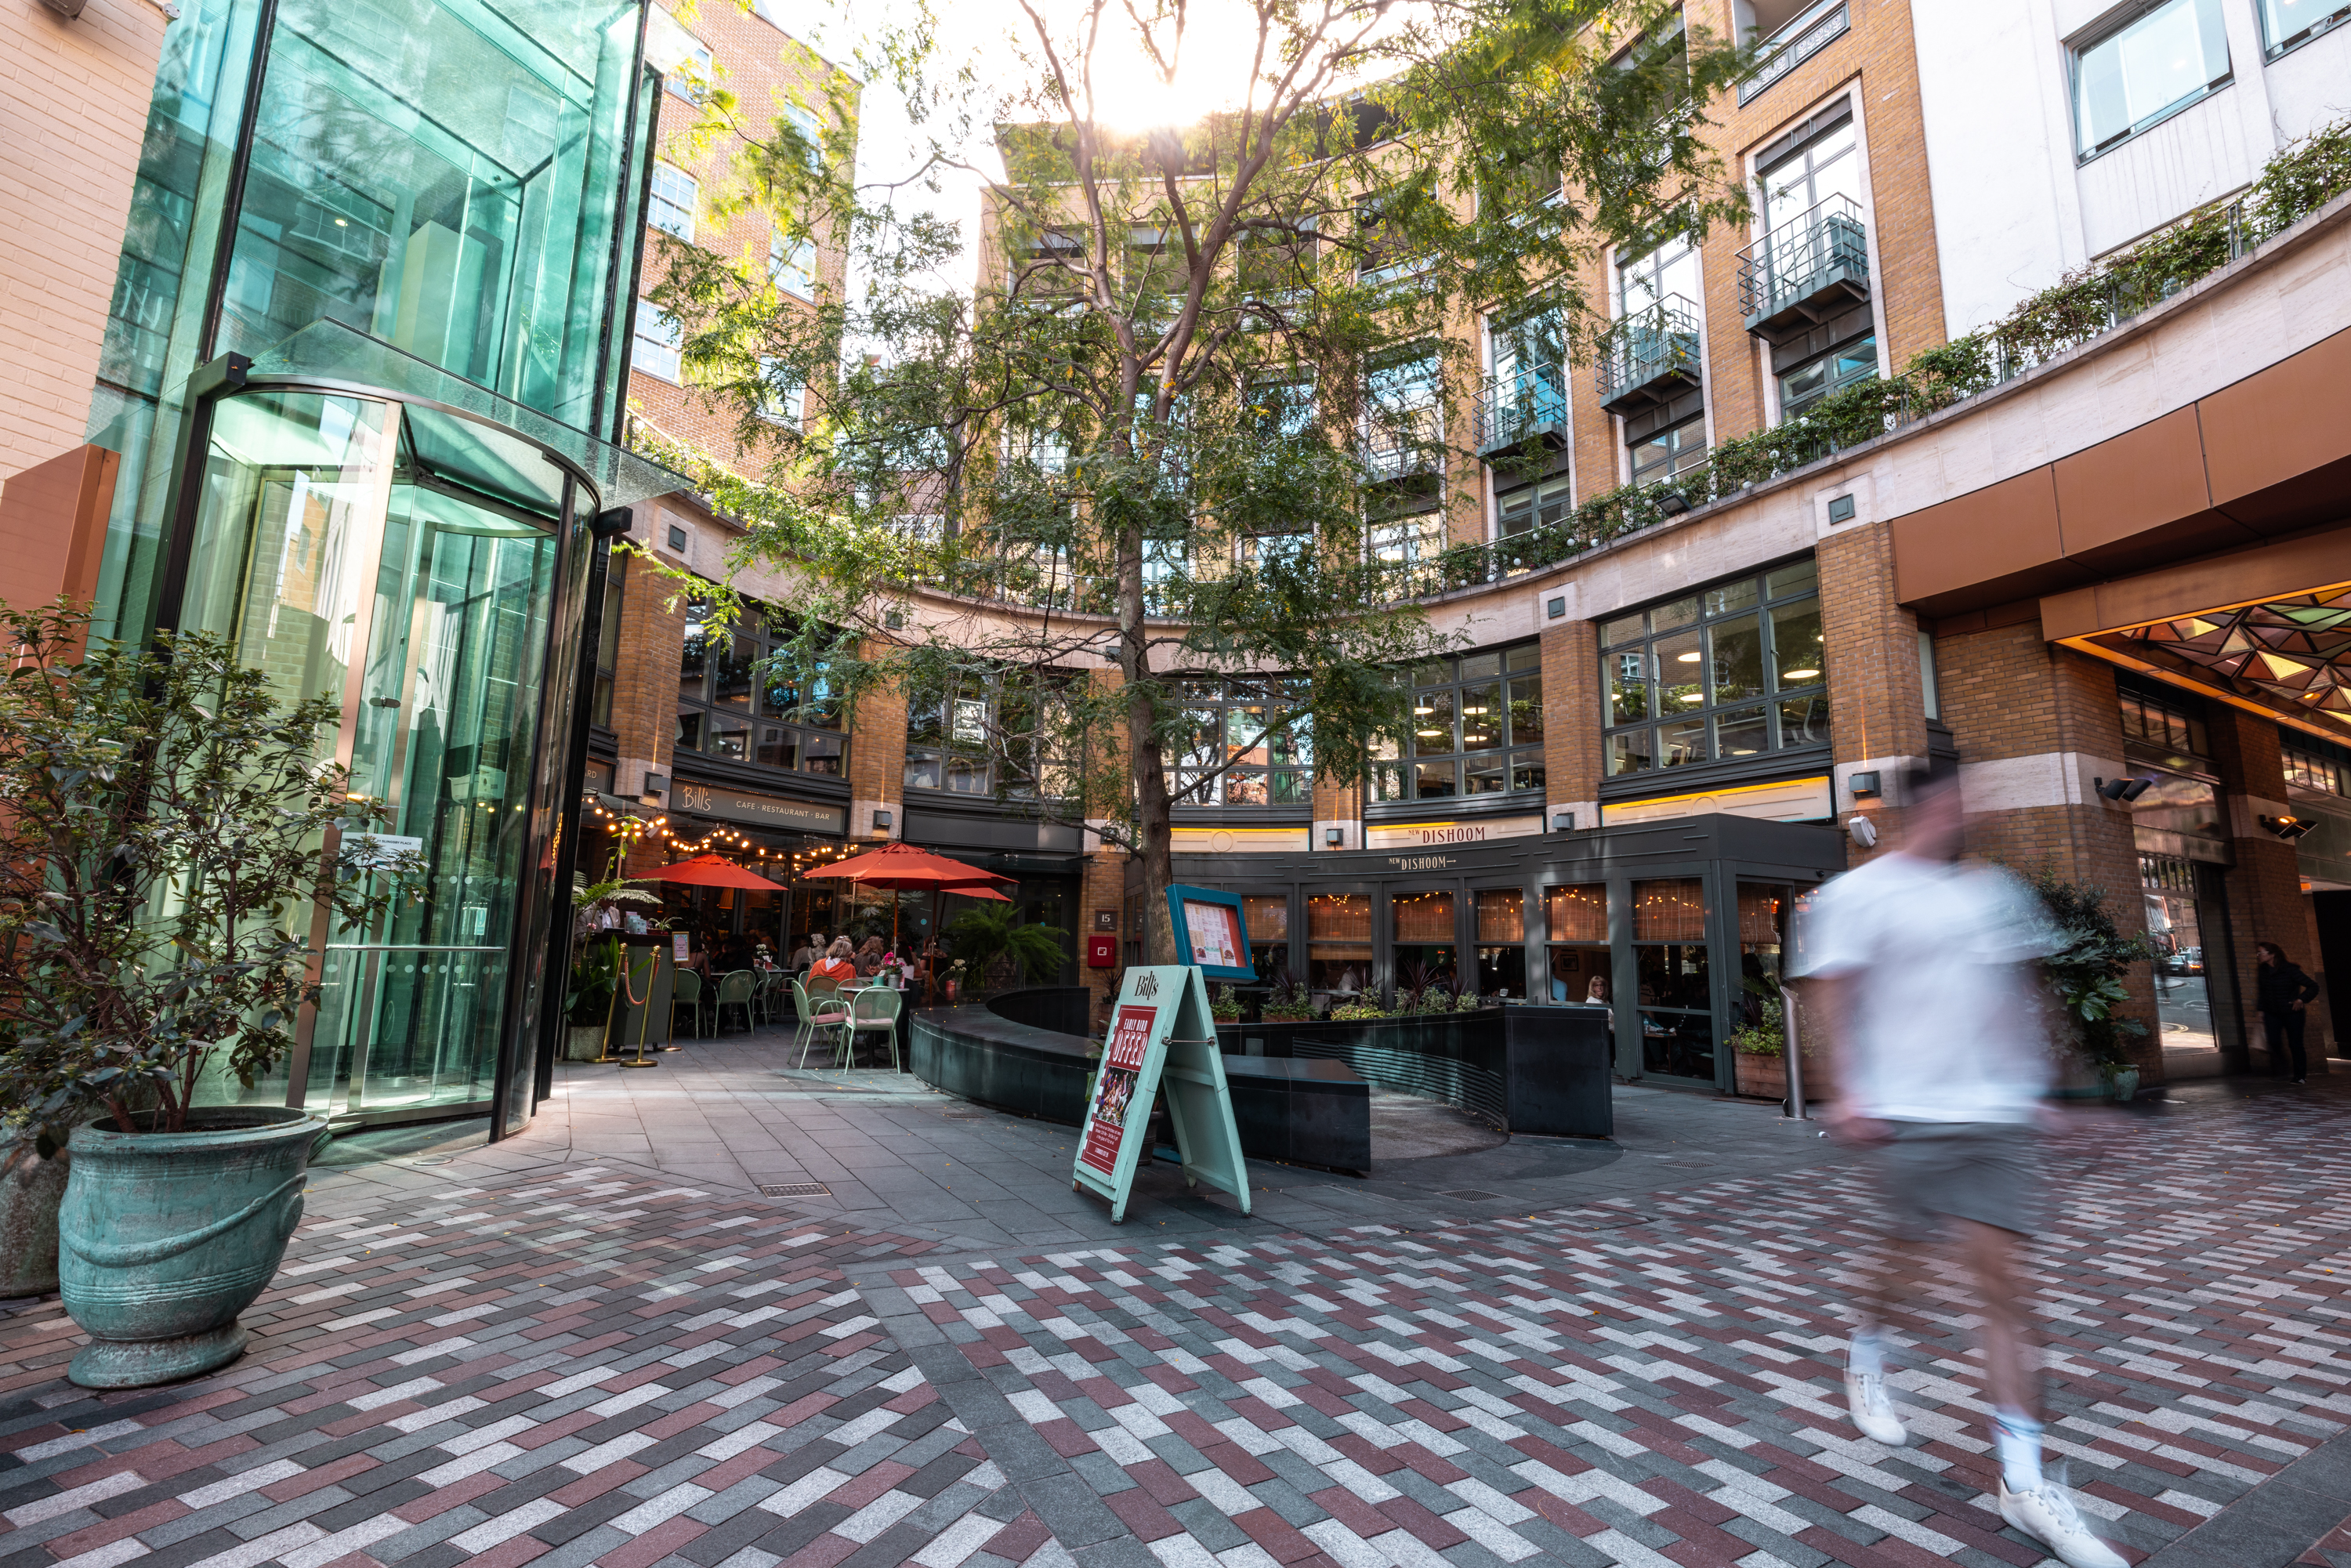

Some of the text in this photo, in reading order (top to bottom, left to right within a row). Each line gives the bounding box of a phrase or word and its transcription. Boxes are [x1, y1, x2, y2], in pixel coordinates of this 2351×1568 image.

[585, 770, 597, 779] RD
[682, 785, 712, 812] Bill's
[736, 801, 830, 820] CAFE RESTAURANT BAR
[1422, 827, 1485, 844] DISHOOM
[1401, 856, 1446, 871] DISHOOM
[1102, 914, 1110, 922] 15
[1134, 970, 1159, 1001] Bill's
[1123, 1018, 1148, 1032] EARLY BIRD
[1112, 1029, 1148, 1066] OFFER
